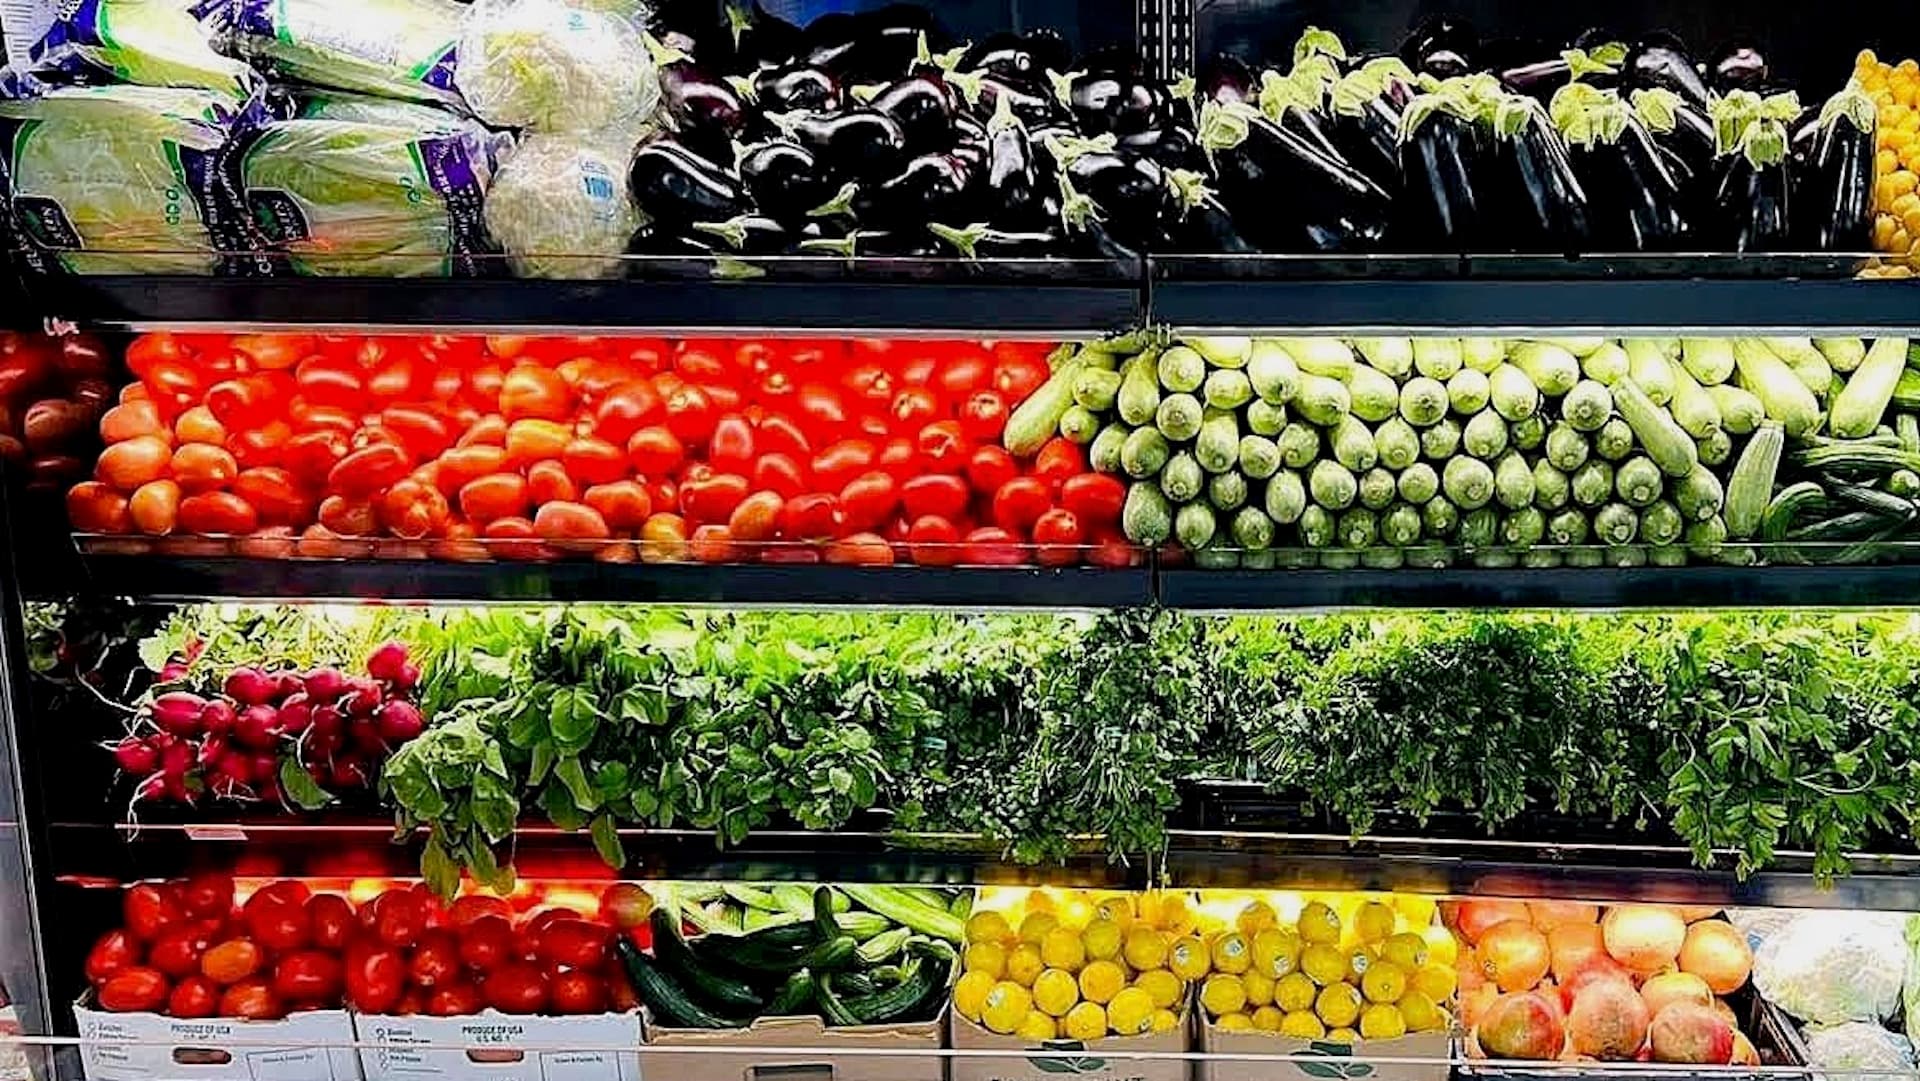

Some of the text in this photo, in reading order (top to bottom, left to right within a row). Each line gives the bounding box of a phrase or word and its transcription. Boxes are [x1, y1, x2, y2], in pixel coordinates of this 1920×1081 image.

[170, 1024, 204, 1034] PRODUCE
[462, 1026, 496, 1034] PRODUCE
[497, 1026, 506, 1034] OF
